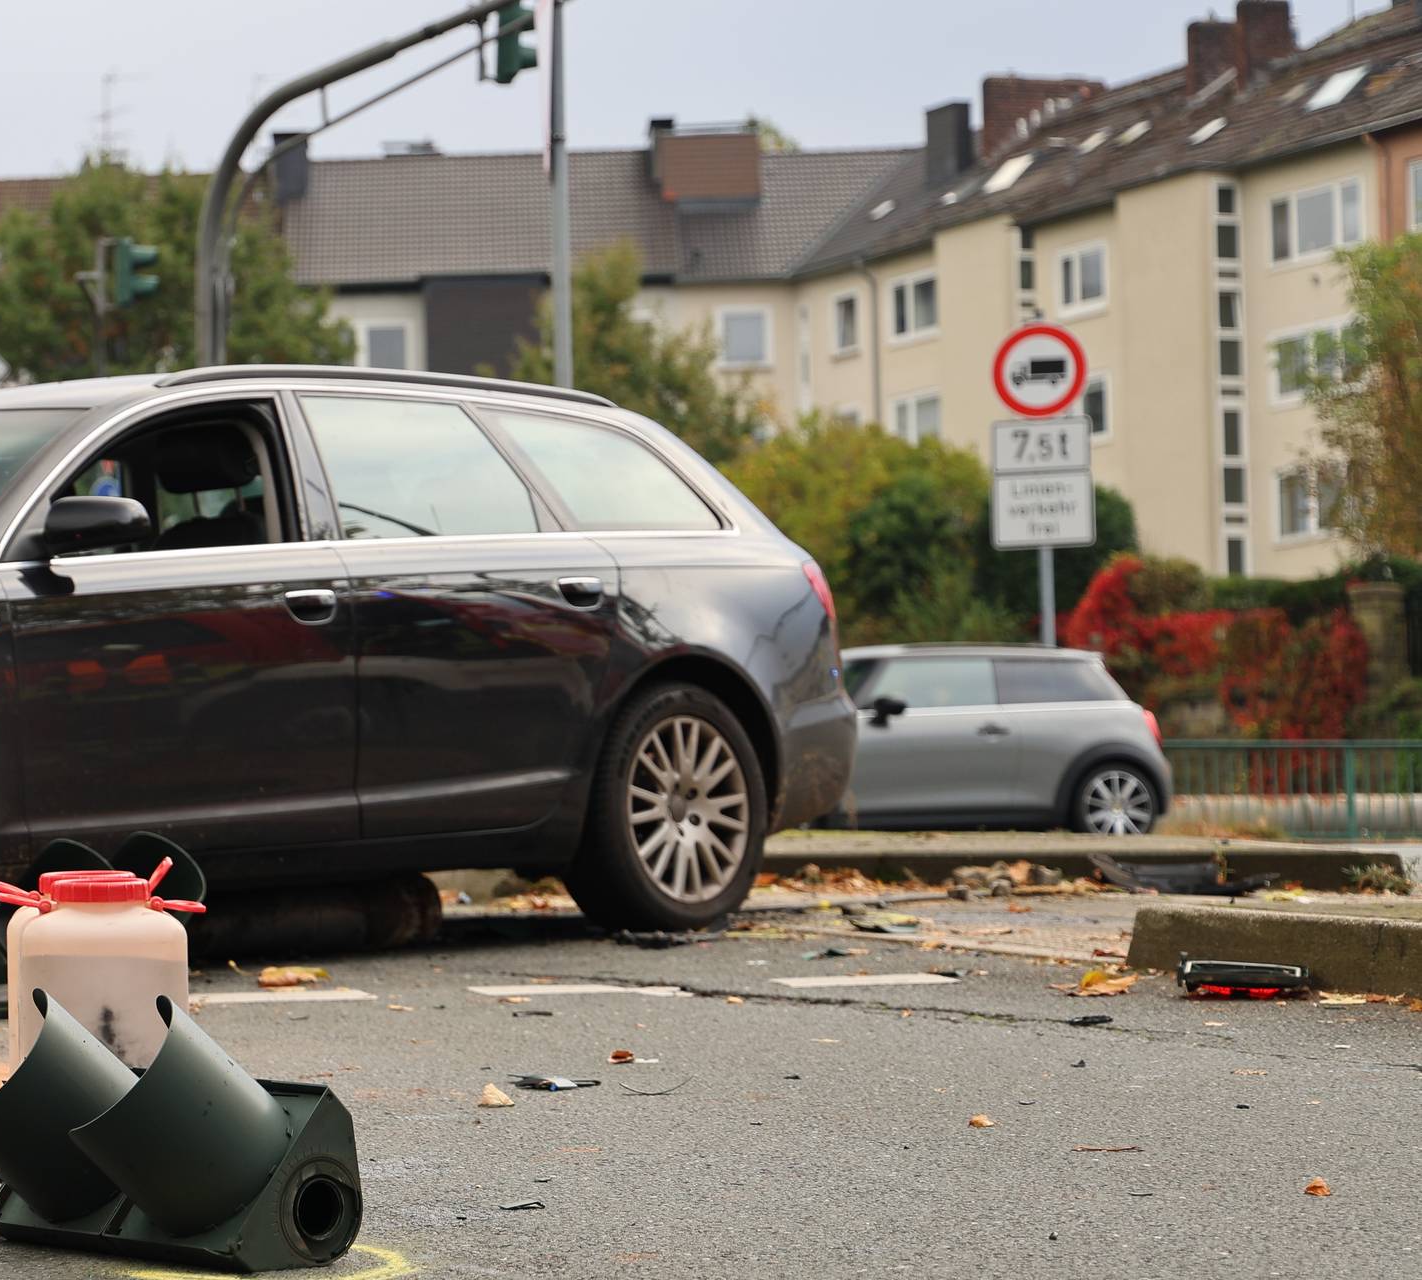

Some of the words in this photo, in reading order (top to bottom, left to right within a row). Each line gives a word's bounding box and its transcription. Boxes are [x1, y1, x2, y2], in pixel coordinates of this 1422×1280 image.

[1012, 429, 1053, 462] 7,5
[1059, 430, 1069, 458] t
[1010, 482, 1074, 498] Linien-
[1009, 500, 1076, 517] verkehr
[1028, 521, 1059, 536] frei
